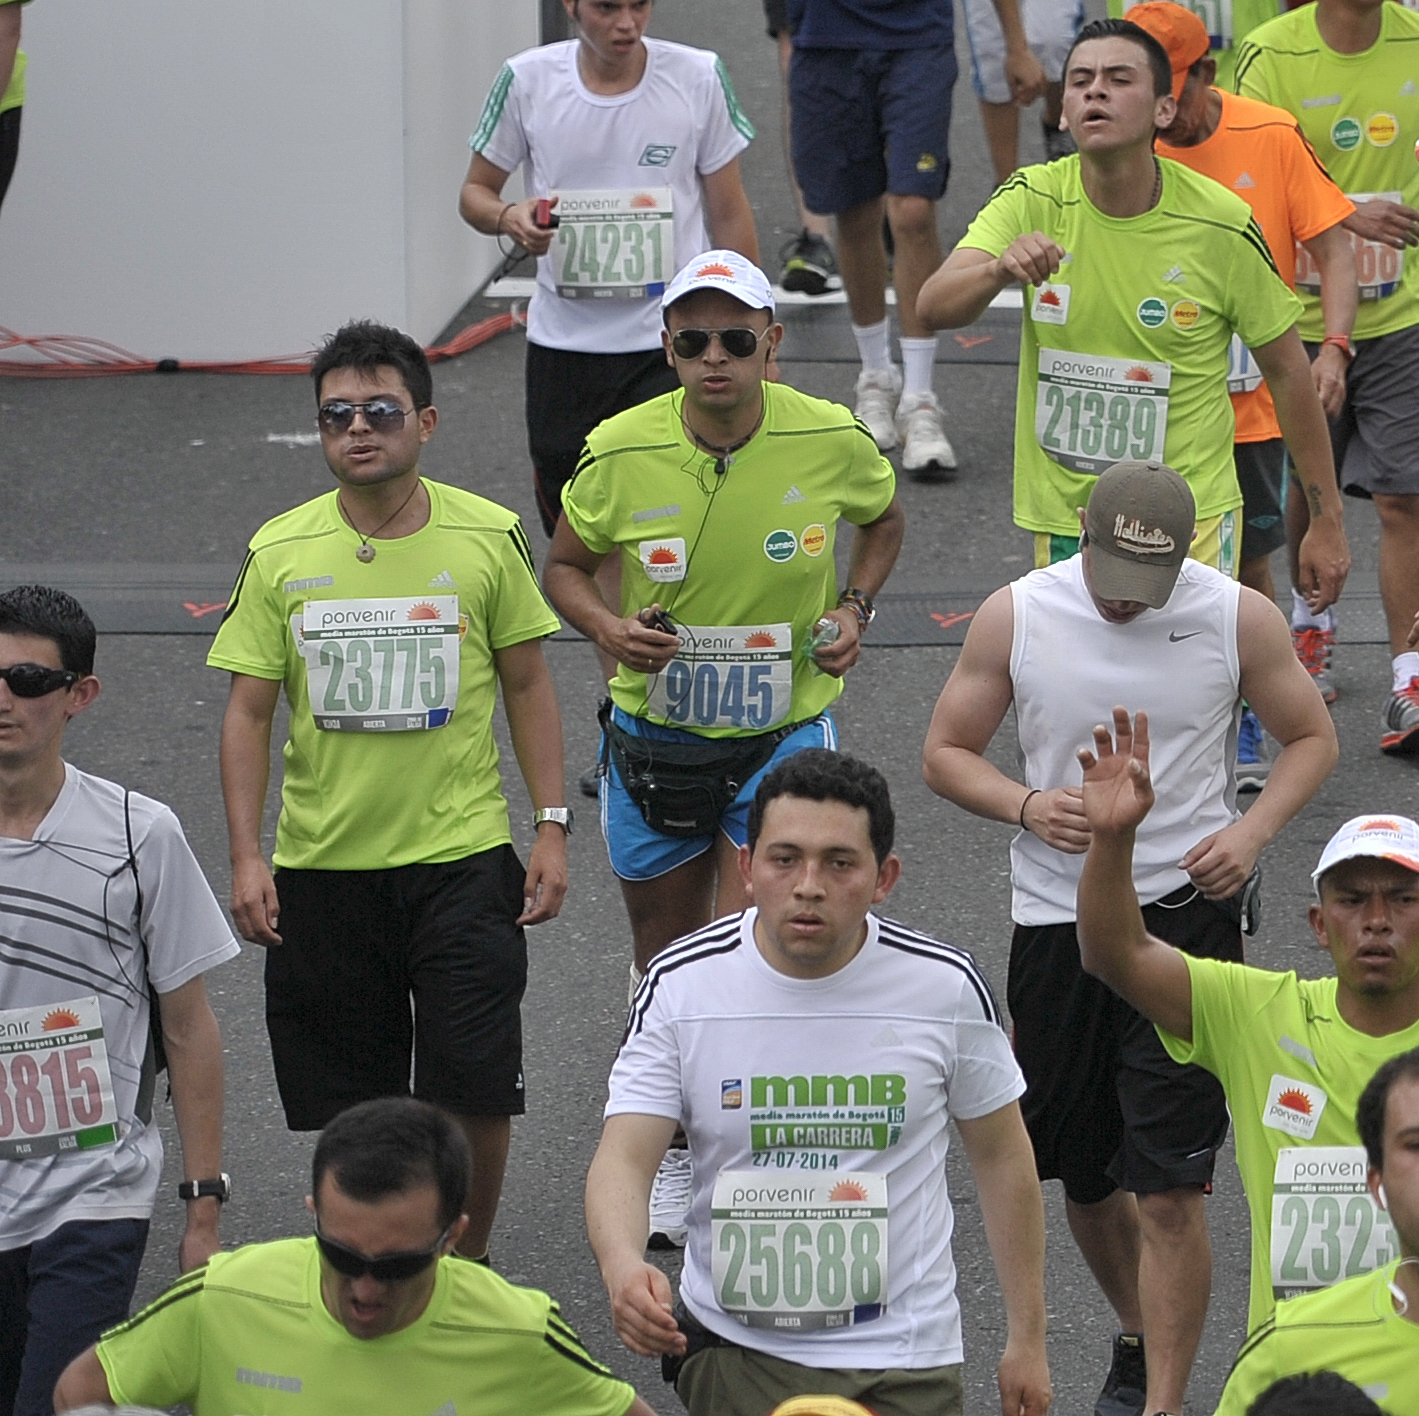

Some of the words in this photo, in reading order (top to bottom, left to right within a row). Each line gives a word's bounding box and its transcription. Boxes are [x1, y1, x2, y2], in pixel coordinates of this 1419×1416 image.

[561, 197, 620, 212] porvenir
[559, 222, 663, 283] 24231
[1051, 359, 1116, 379] porvenir
[1044, 385, 1157, 461] 21389
[765, 540, 796, 551] JUMBO
[322, 608, 396, 627] porvenir
[319, 629, 343, 639] media
[344, 627, 375, 638] maratón
[376, 626, 387, 637] de
[387, 626, 415, 639] Bogotá
[417, 626, 426, 635] 15
[426, 625, 445, 635] años
[677, 636, 735, 650] orvenir
[319, 638, 446, 712] 23775
[665, 660, 773, 727] 9045
[749, 1073, 907, 1107] mmB
[749, 1112, 781, 1122] media
[784, 1110, 830, 1122] maratón
[832, 1110, 845, 1121] de
[847, 1109, 886, 1125] Bogotá
[890, 1106, 904, 1124] 15
[1269, 1103, 1315, 1128] porvenir
[764, 1127, 790, 1146] LA
[792, 1127, 874, 1147] CARRERA
[752, 1151, 839, 1171] 27-07-2014
[732, 1187, 816, 1207] porvenir
[730, 1208, 751, 1218] media
[753, 1208, 790, 1218] maratón
[791, 1208, 804, 1218] de
[805, 1208, 837, 1220] Bogotá
[838, 1208, 848, 1218] 15
[849, 1208, 872, 1218] años
[719, 1222, 882, 1307] 25688
